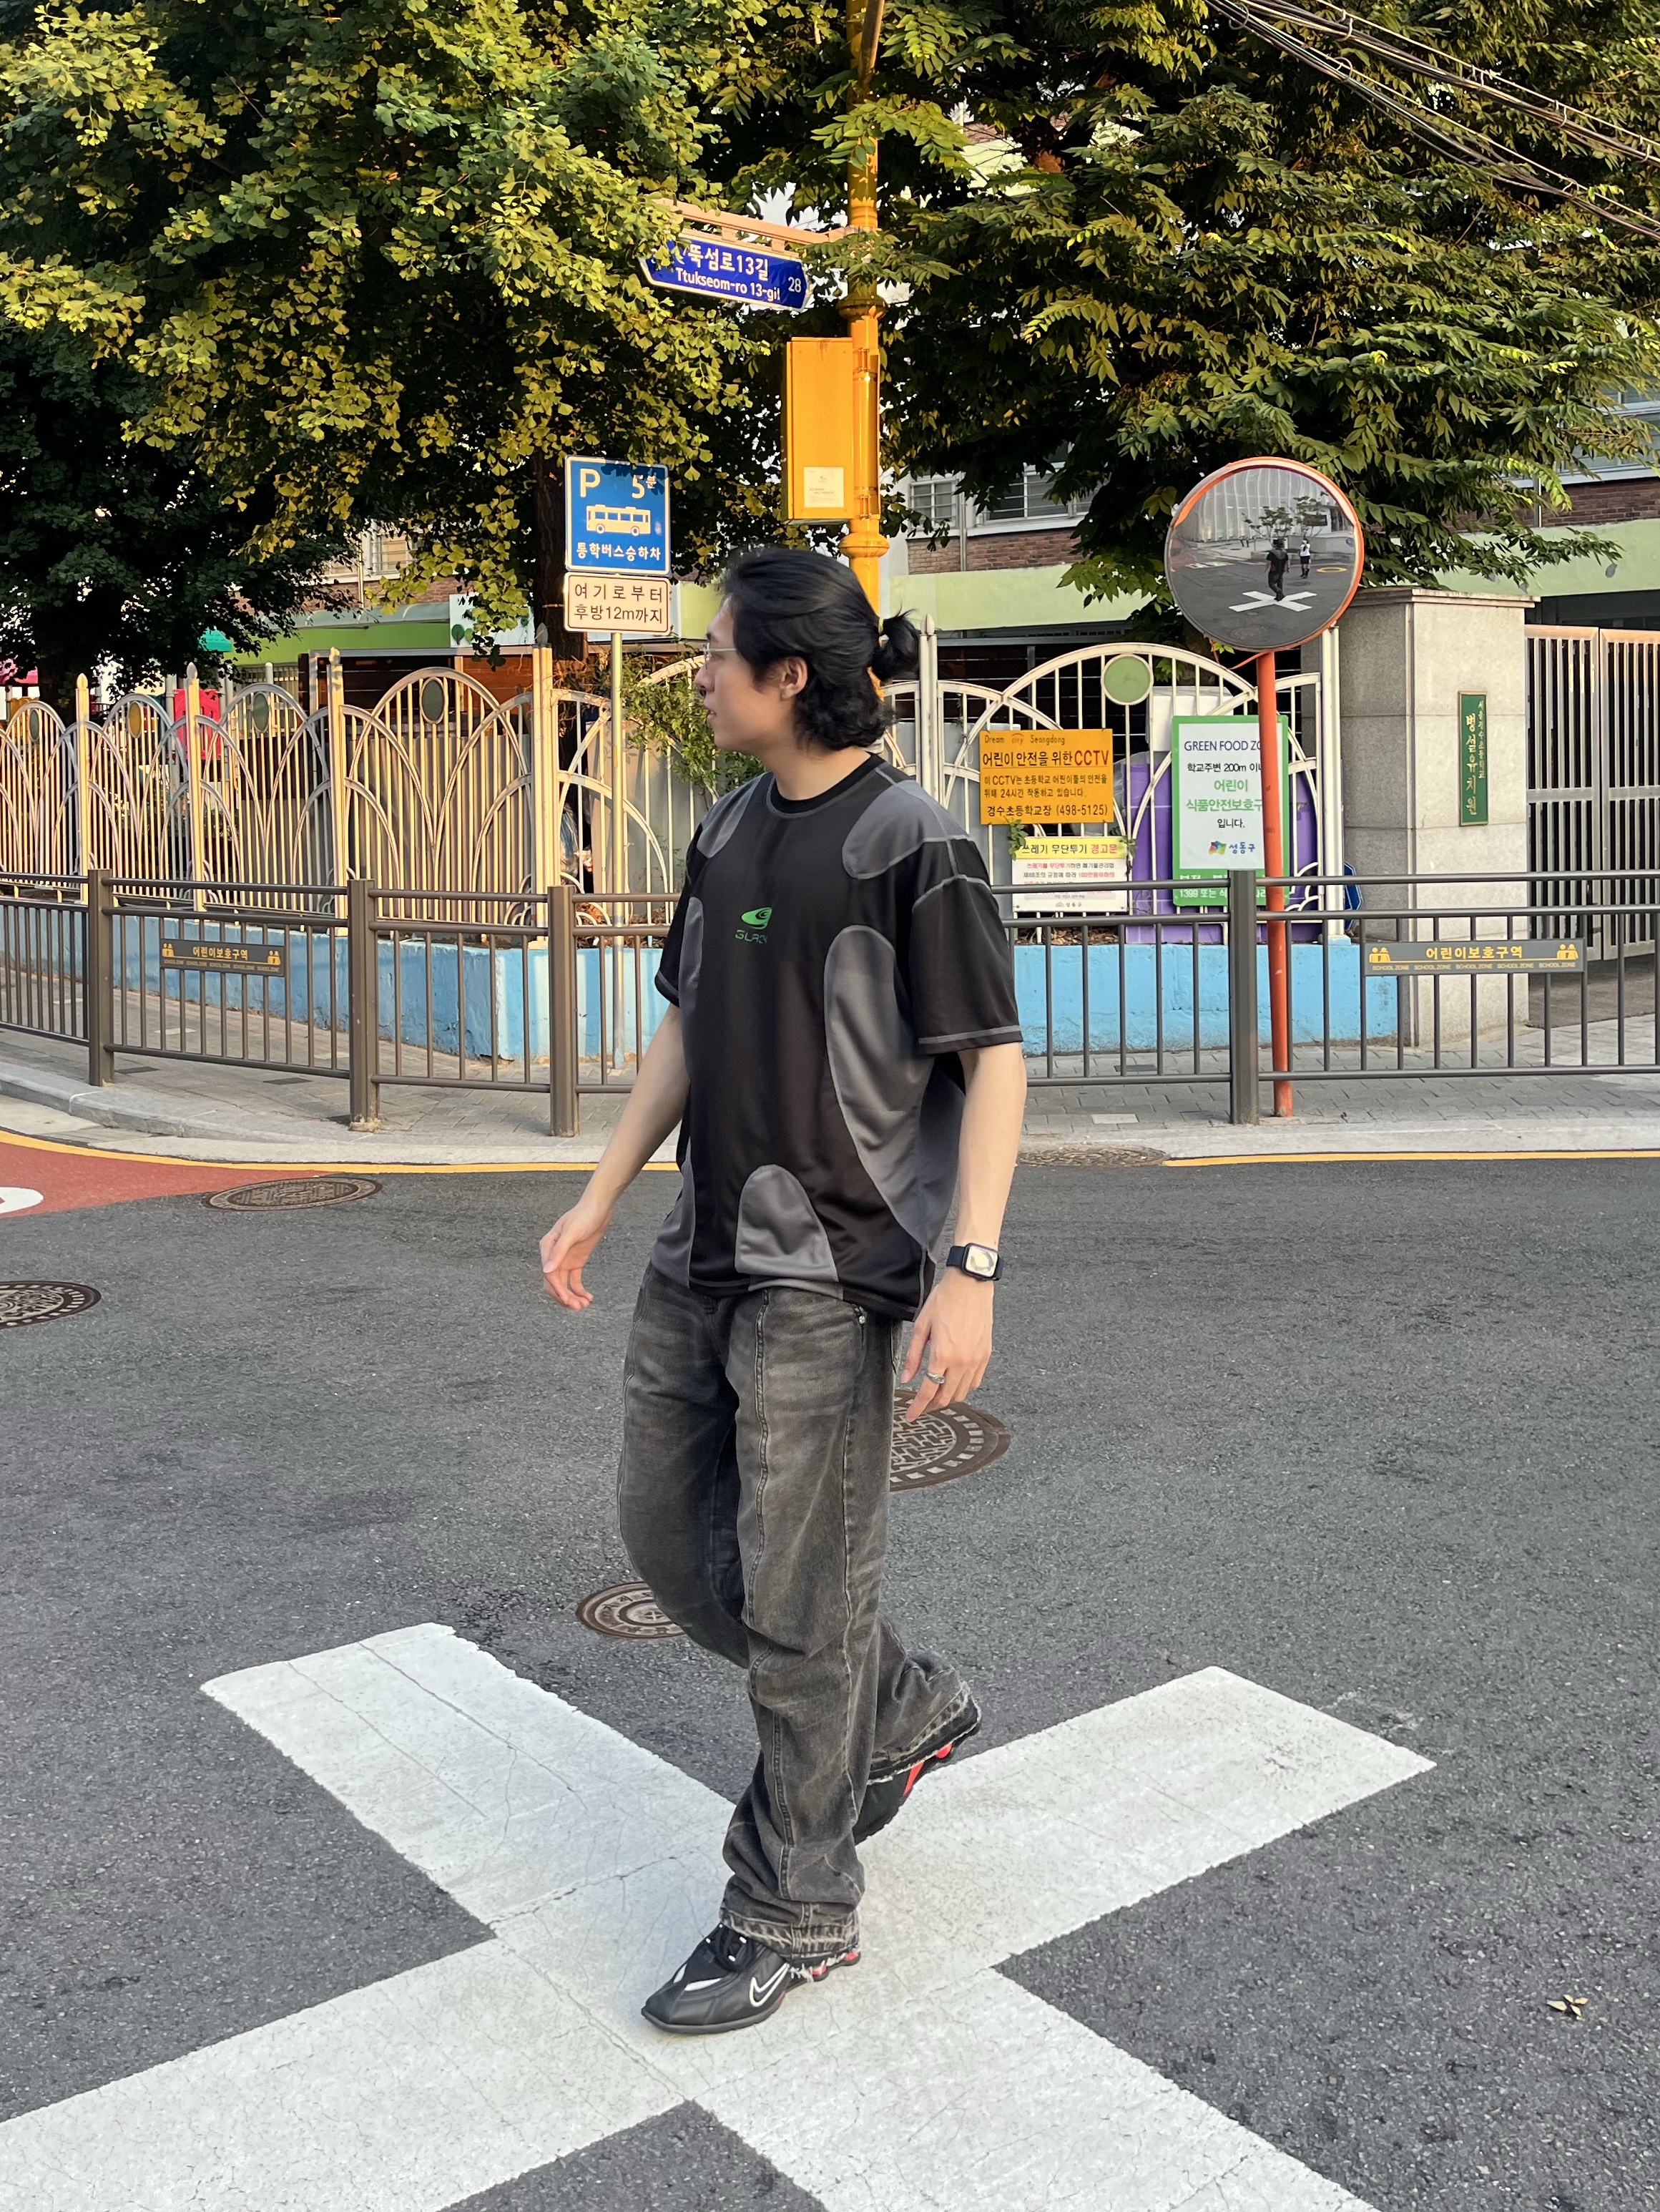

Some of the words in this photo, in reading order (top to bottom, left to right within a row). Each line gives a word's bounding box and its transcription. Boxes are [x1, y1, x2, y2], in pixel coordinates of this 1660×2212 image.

[687, 244, 768, 281] 뚝섬로13길
[675, 267, 747, 294] Ttukseom-ro
[750, 282, 780, 301] 13-gil
[787, 276, 802, 293] 28
[580, 468, 601, 497] P
[576, 542, 661, 562] 통학버스승하차
[574, 603, 662, 624] 후방12m까지
[985, 735, 1004, 743] Dream
[1184, 740, 1217, 751] GREEN
[1219, 740, 1249, 750] FOOD
[983, 752, 1013, 766] 어린이
[1016, 751, 1048, 766] 안전을
[1051, 751, 1072, 765] 위한
[1074, 750, 1109, 765] CCTV
[1466, 713, 1478, 815] 병설유치원
[1187, 763, 1221, 773] 학교주변
[1224, 763, 1247, 772] 200m
[985, 776, 991, 785] 이
[993, 775, 1023, 786] CCTV는
[1024, 775, 1051, 785] 초등학교
[1088, 773, 1107, 784] 안전을
[1214, 779, 1248, 792] 어린이
[1001, 788, 1023, 798] 24시간
[1027, 788, 1054, 798] 작동하고
[987, 805, 1051, 817] 경수초등학교장
[1056, 804, 1108, 816] (498-5125)
[1186, 798, 1262, 812] 식품안전보호구
[1217, 818, 1245, 828] 입니다.
[1022, 844, 1048, 854] 쓰레기
[1051, 844, 1087, 854] 무단투기
[1091, 843, 1117, 854] 경고문
[1229, 841, 1255, 854] 성동구
[1179, 889, 1198, 898] 1399
[192, 946, 248, 961] 어린이보호구역
[1425, 946, 1523, 960] 어린이보호구역
